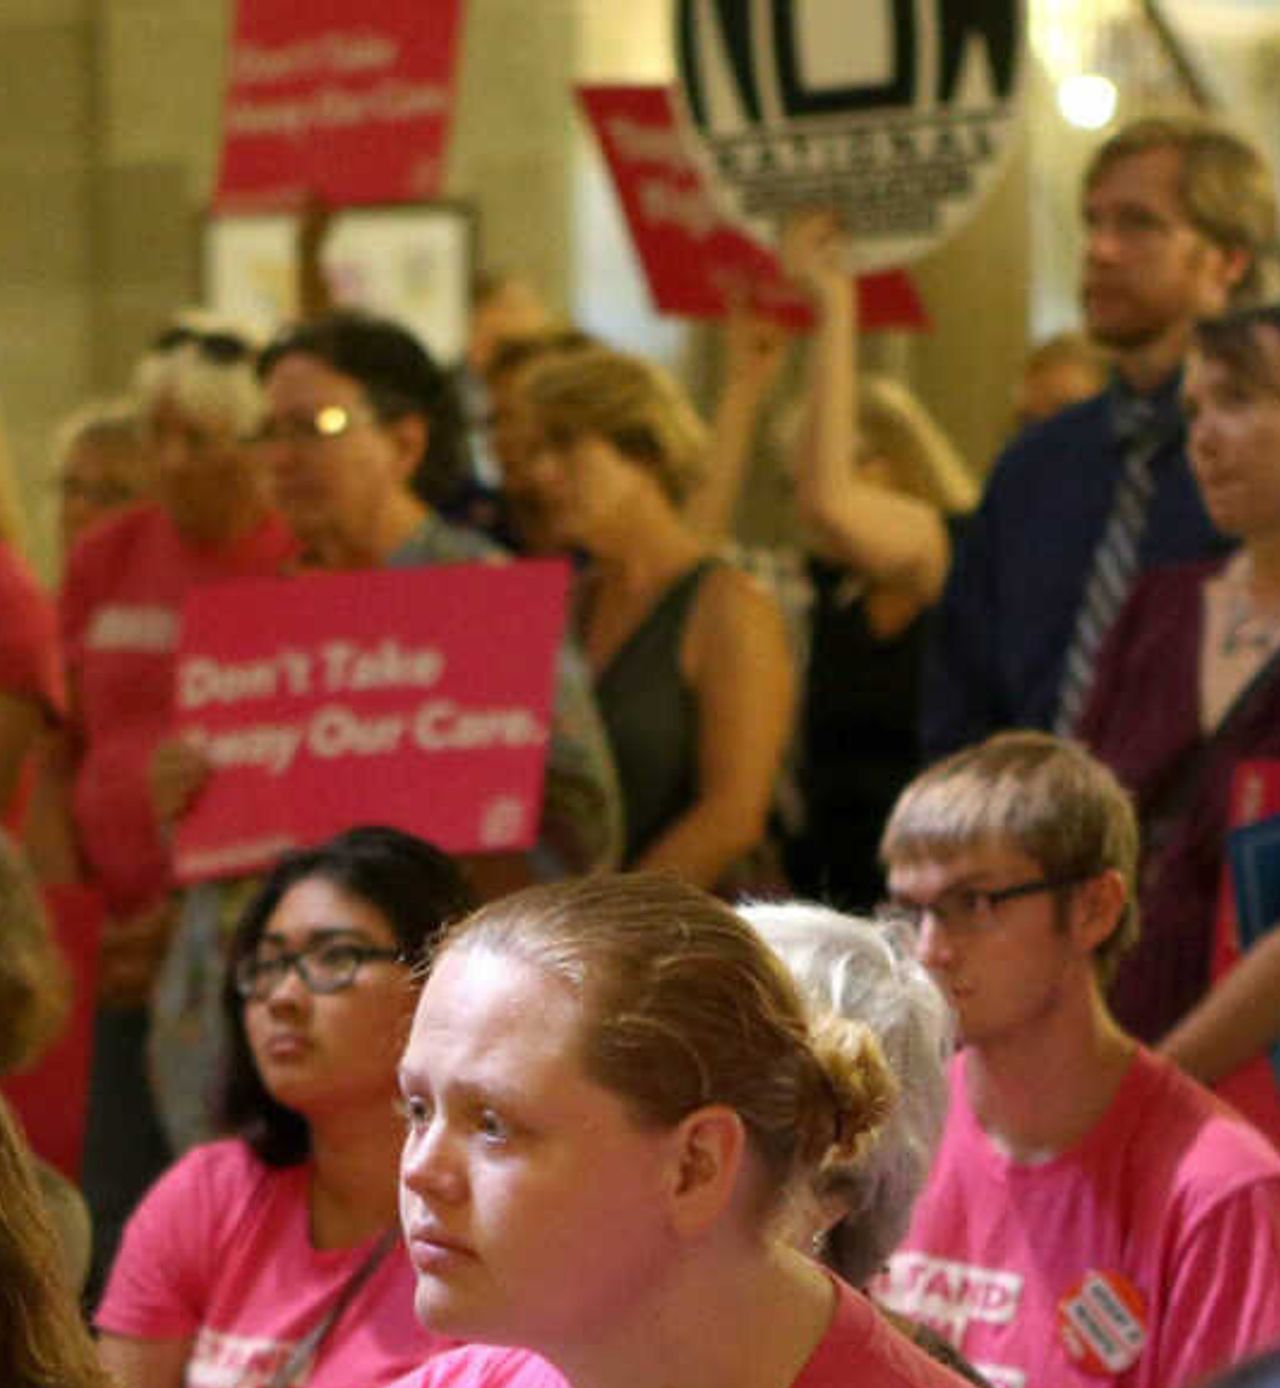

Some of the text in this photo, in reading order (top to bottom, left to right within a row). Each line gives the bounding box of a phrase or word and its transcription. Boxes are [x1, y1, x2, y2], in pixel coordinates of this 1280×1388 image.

[179, 640, 442, 709] Don't Take
[308, 705, 402, 758] Our
